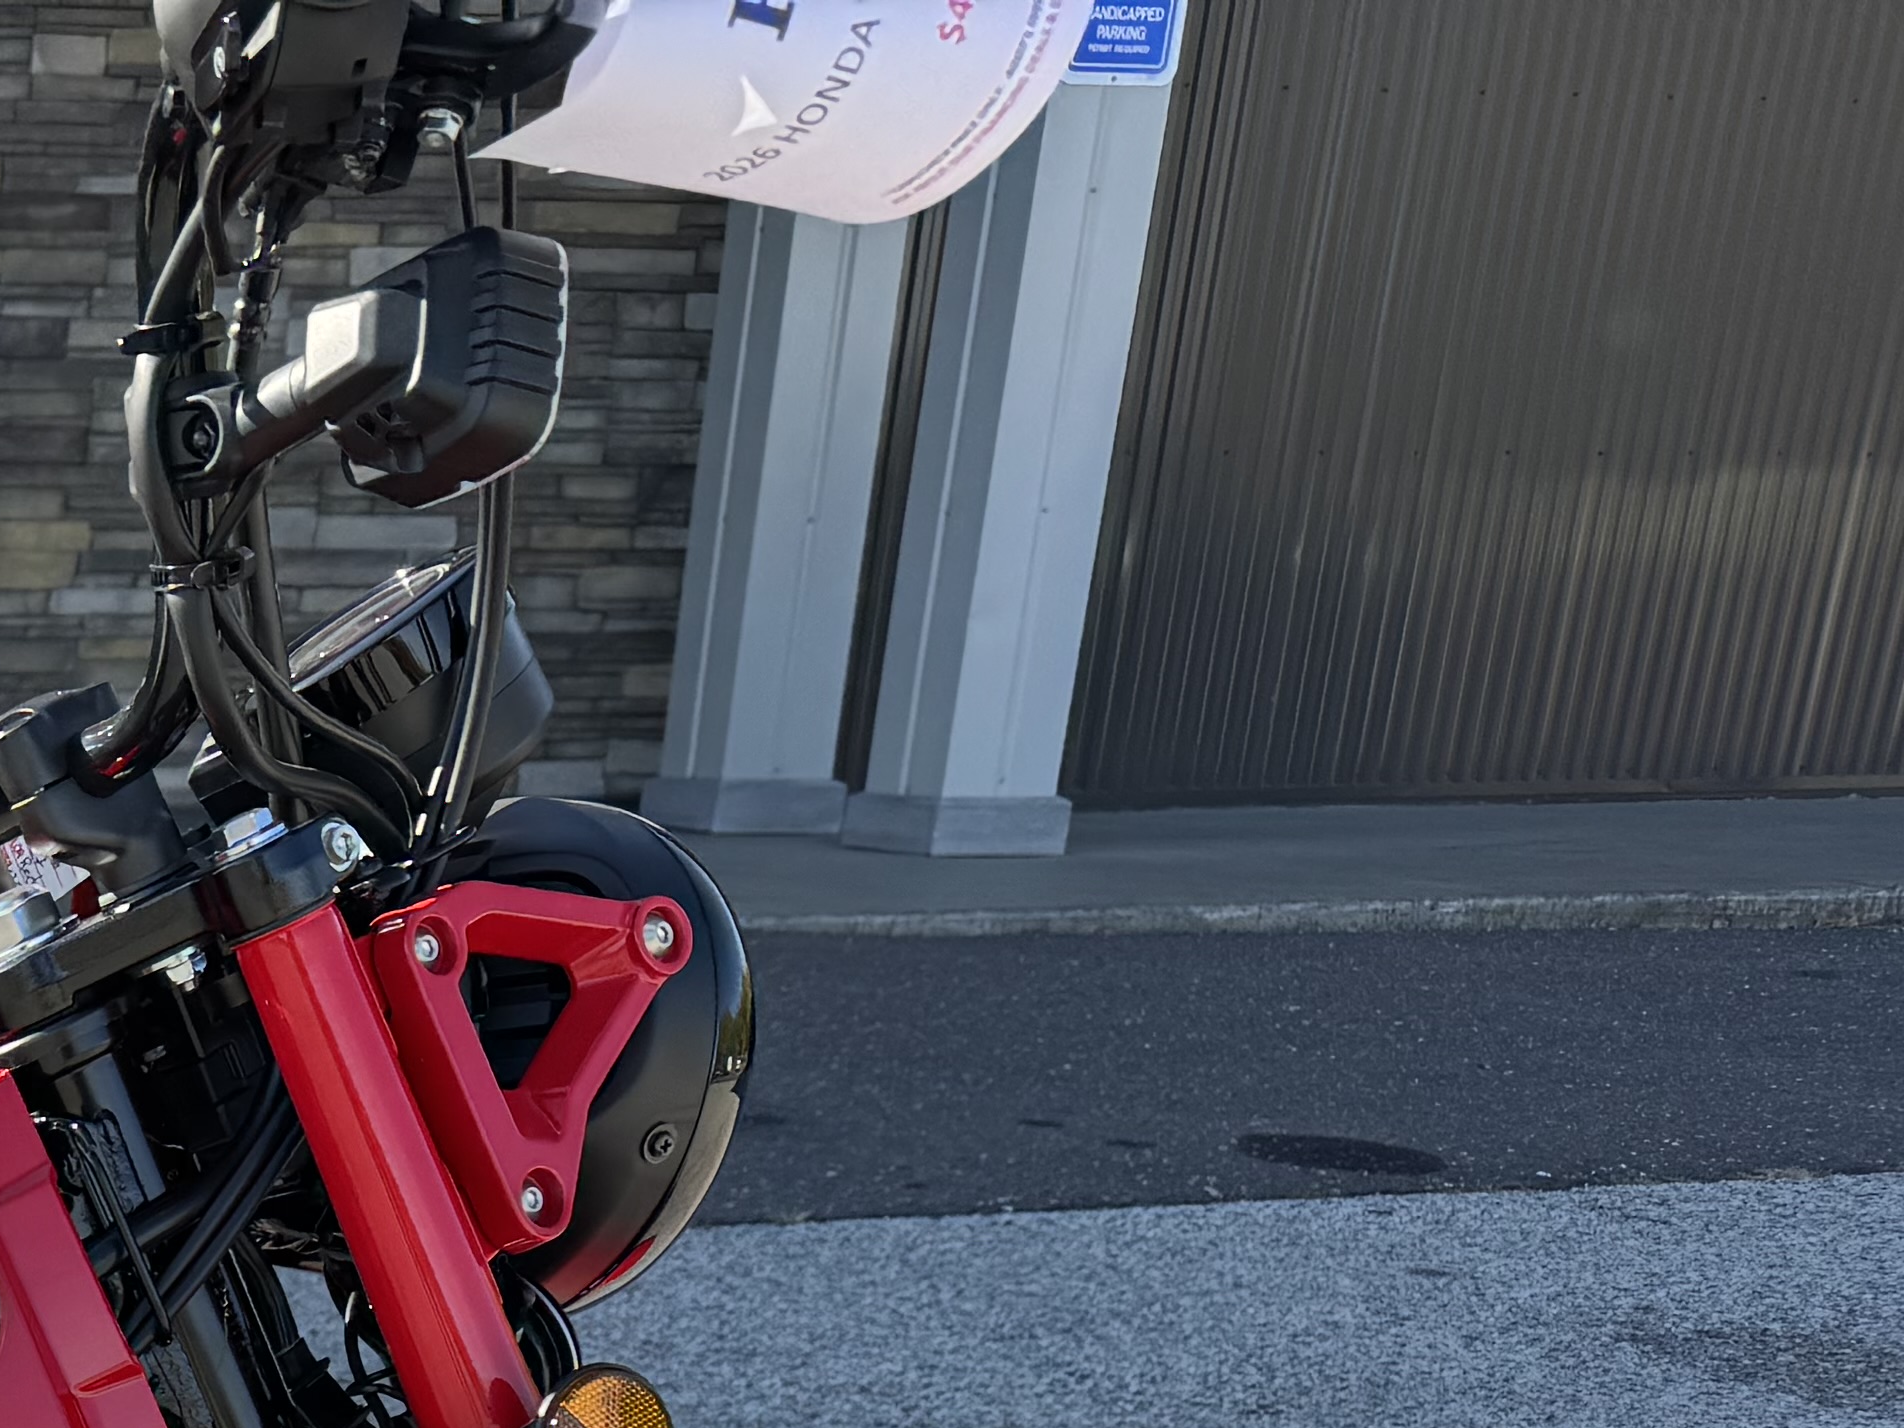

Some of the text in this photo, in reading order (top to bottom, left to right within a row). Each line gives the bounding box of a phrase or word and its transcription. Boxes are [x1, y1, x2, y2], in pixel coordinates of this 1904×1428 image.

[1091, 6, 1165, 21] ANDICAPPED
[1096, 24, 1147, 40] PARKING
[702, 147, 782, 182] 2026
[772, 18, 881, 144] HONDA
